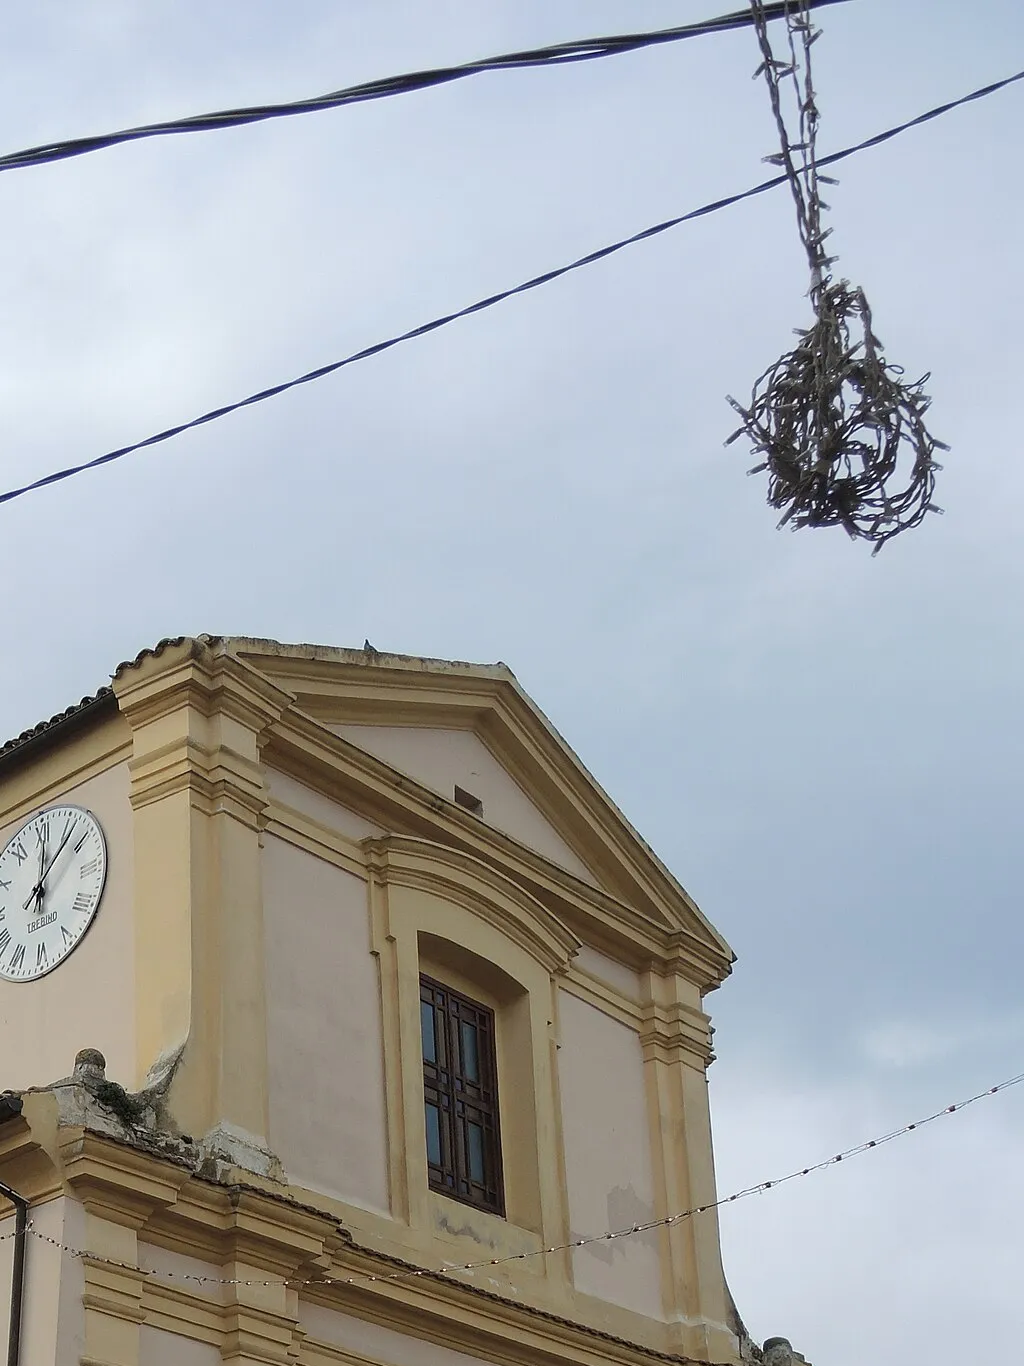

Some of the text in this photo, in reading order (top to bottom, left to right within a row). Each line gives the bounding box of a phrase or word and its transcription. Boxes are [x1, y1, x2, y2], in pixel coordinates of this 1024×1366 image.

[35, 821, 50, 848] XII
[12, 842, 28, 866] XI
[80, 858, 98, 879] III
[27, 911, 58, 934] TREBINO
[60, 925, 73, 945] V
[9, 943, 26, 969] VII
[36, 941, 48, 966] VI
